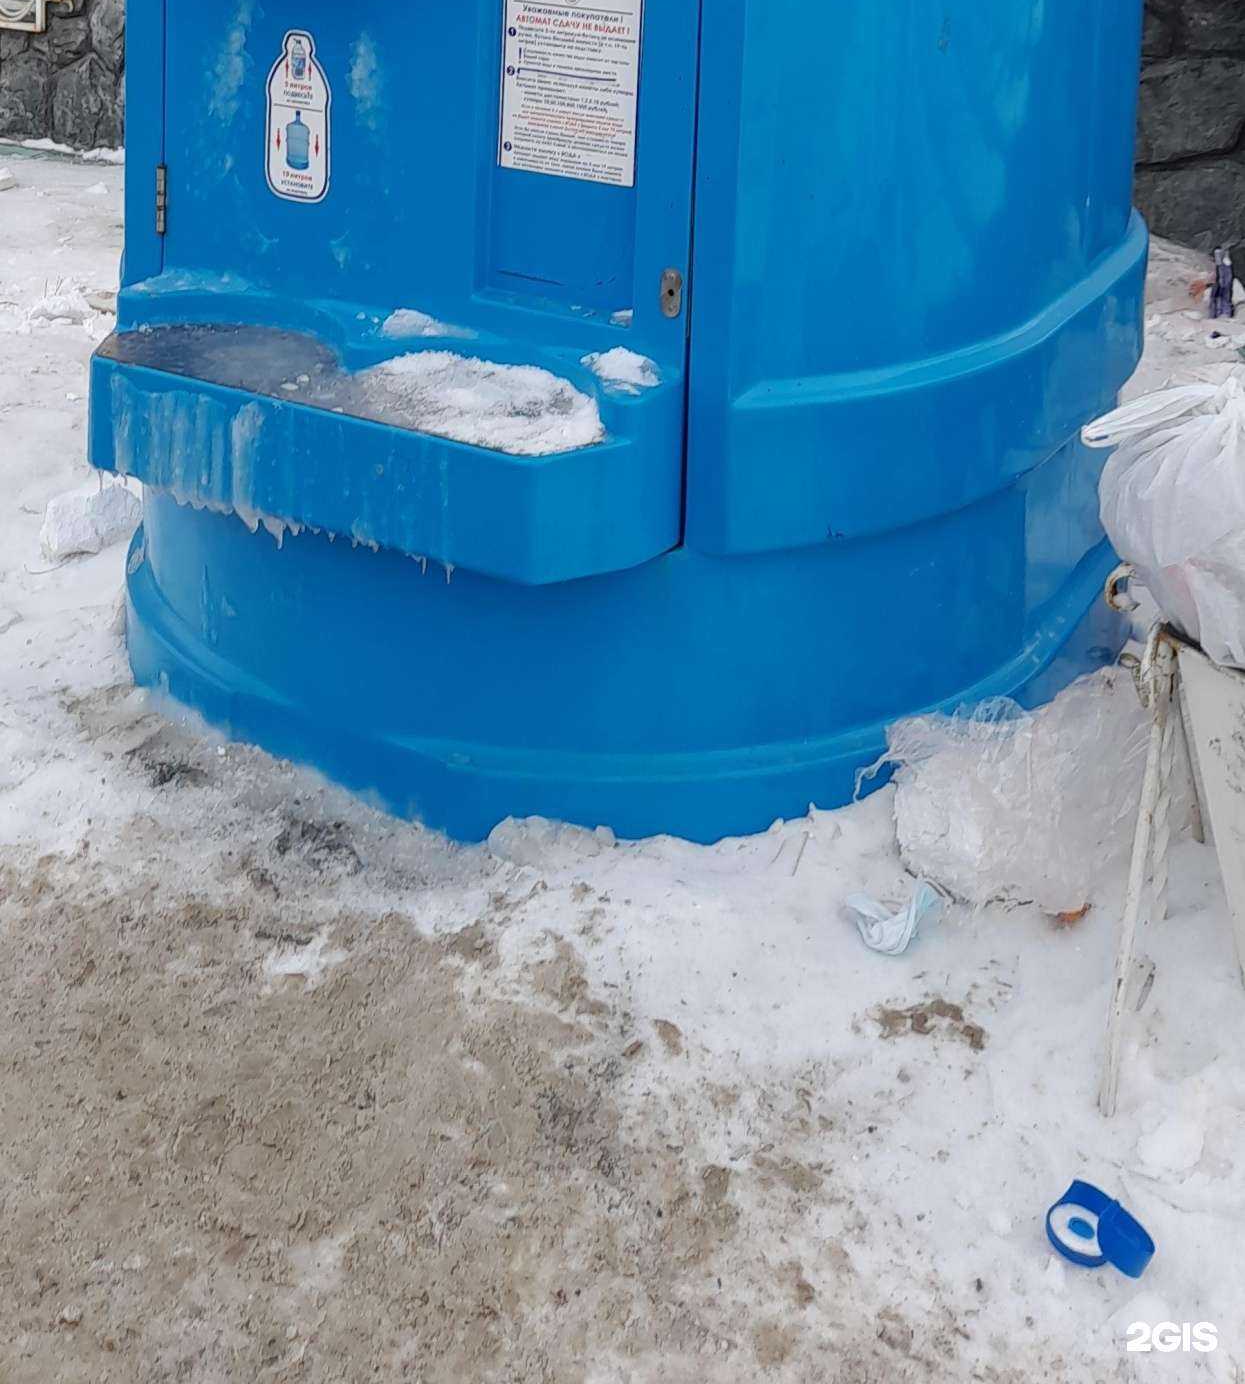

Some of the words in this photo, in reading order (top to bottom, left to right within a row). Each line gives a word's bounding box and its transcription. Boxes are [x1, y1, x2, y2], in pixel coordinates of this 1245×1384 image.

[516, 14, 551, 26] АВТОМАТ
[552, 19, 580, 30] СДАЧУ
[581, 22, 593, 30] НЕ
